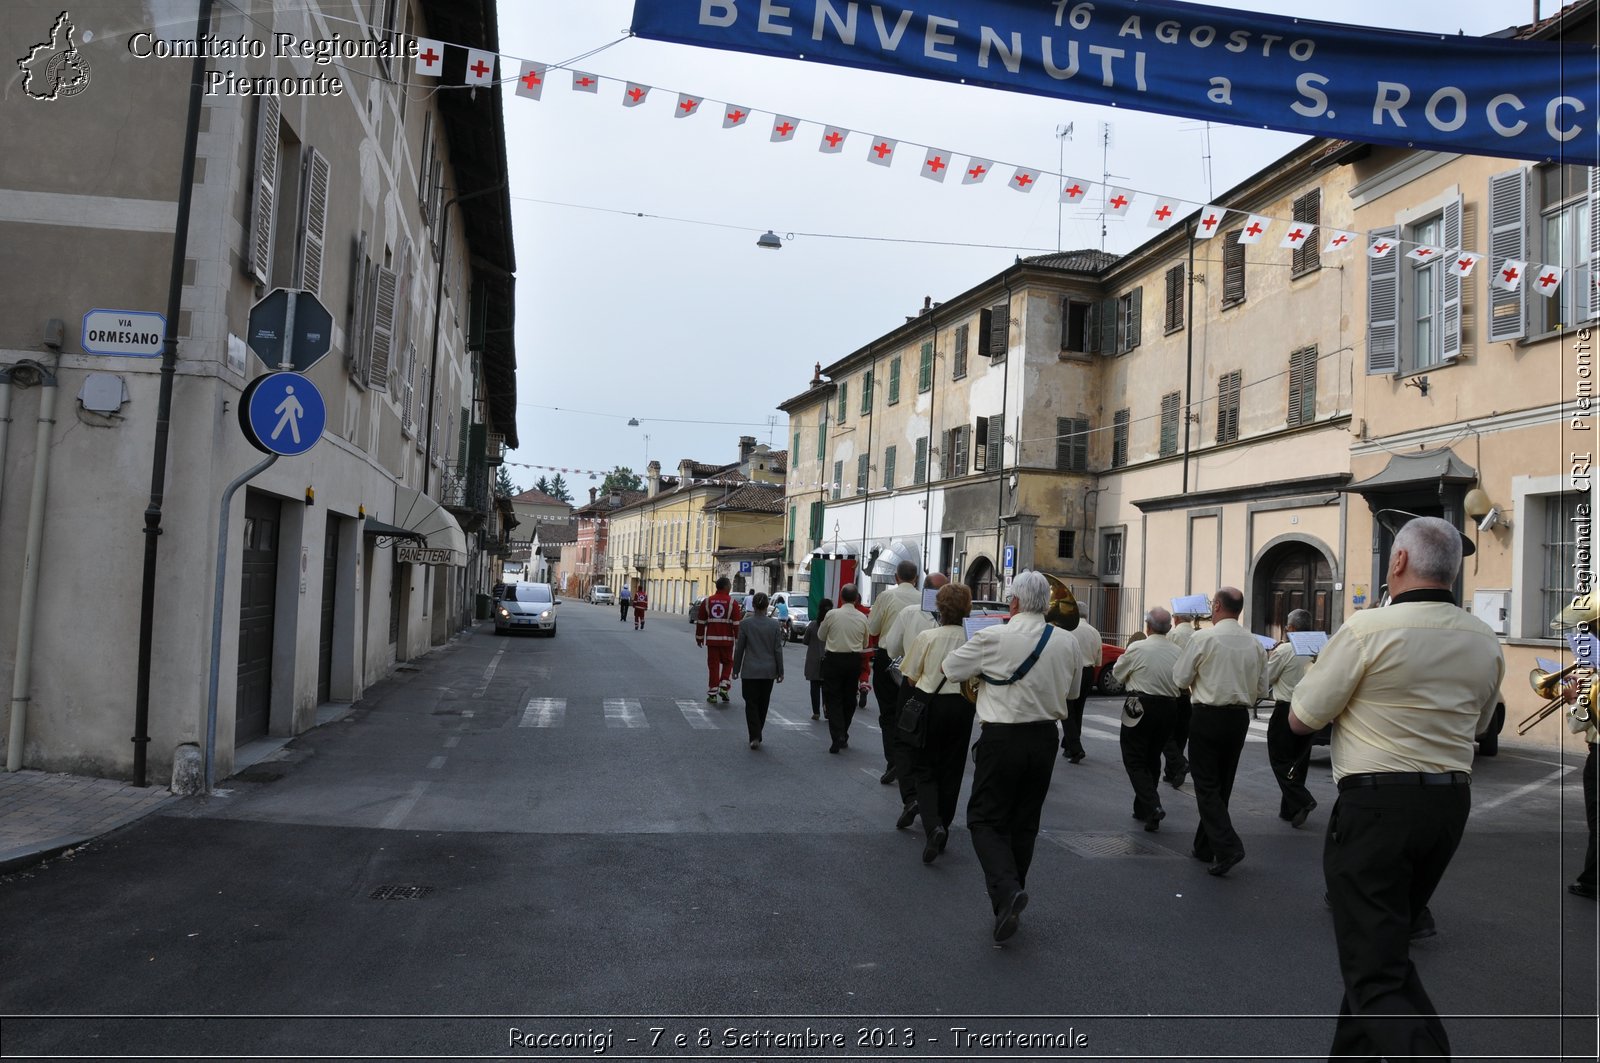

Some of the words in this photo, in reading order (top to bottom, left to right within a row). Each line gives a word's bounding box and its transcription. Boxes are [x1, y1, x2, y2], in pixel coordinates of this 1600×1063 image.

[1054, 0, 1095, 30] 16
[1118, 15, 1315, 62] AGOSTO
[699, 0, 1147, 92] BENVENUTI
[1207, 76, 1232, 105] a
[1290, 72, 1336, 119] S.
[1372, 81, 1600, 142] ROCC
[118, 319, 132, 327] VIA
[89, 330, 159, 345] ORMESANO
[399, 548, 452, 563] PANETTERIA
[1006, 548, 1011, 566] P
[742, 562, 749, 571] P
